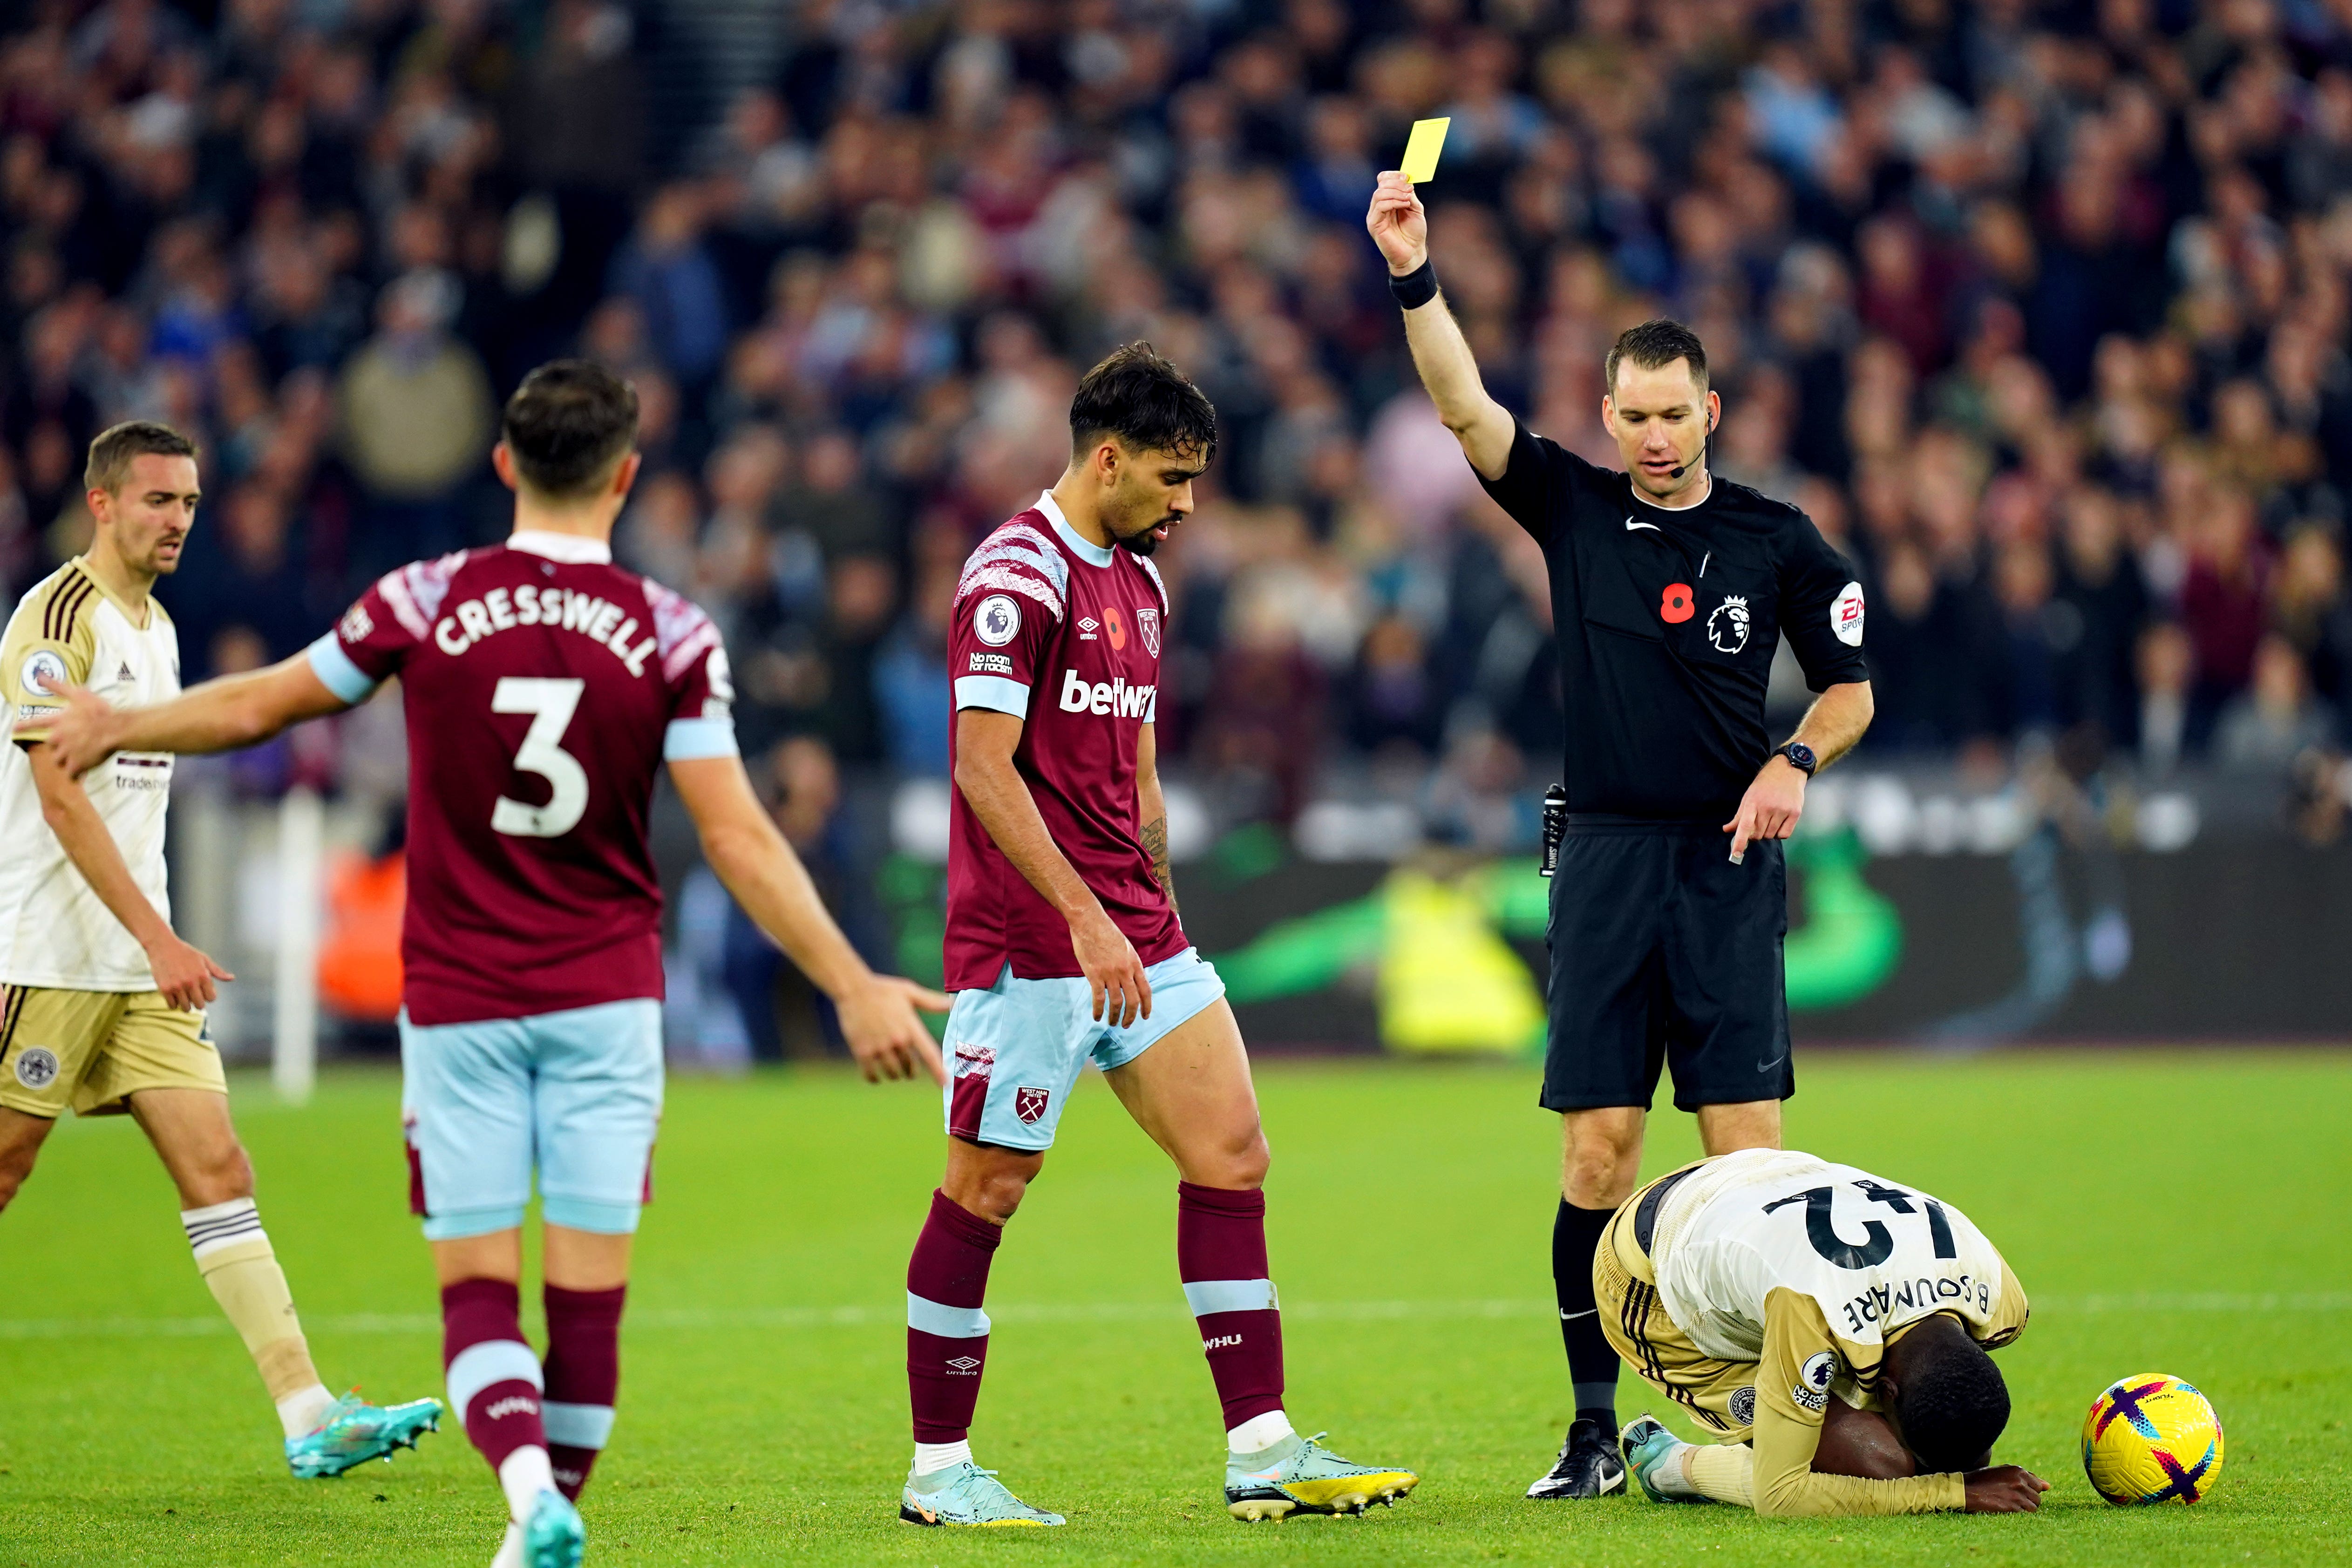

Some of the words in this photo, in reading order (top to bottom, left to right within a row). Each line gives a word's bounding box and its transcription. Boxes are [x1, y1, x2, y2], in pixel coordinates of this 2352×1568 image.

[1842, 597, 1864, 621] EA
[435, 584, 657, 678] CRESSWELL
[1842, 617, 1864, 632] SPOR
[969, 662, 984, 671] for
[984, 663, 1012, 675] racism
[970, 652, 985, 663] No
[986, 654, 1010, 665] room
[490, 677, 589, 838] 3
[1761, 1180, 1957, 1269] 42
[1203, 1334, 1243, 1351] WHU
[1792, 1384, 1809, 1398] No
[1809, 1394, 1828, 1403] room
[1733, 1392, 1747, 1418] LEICESTER
